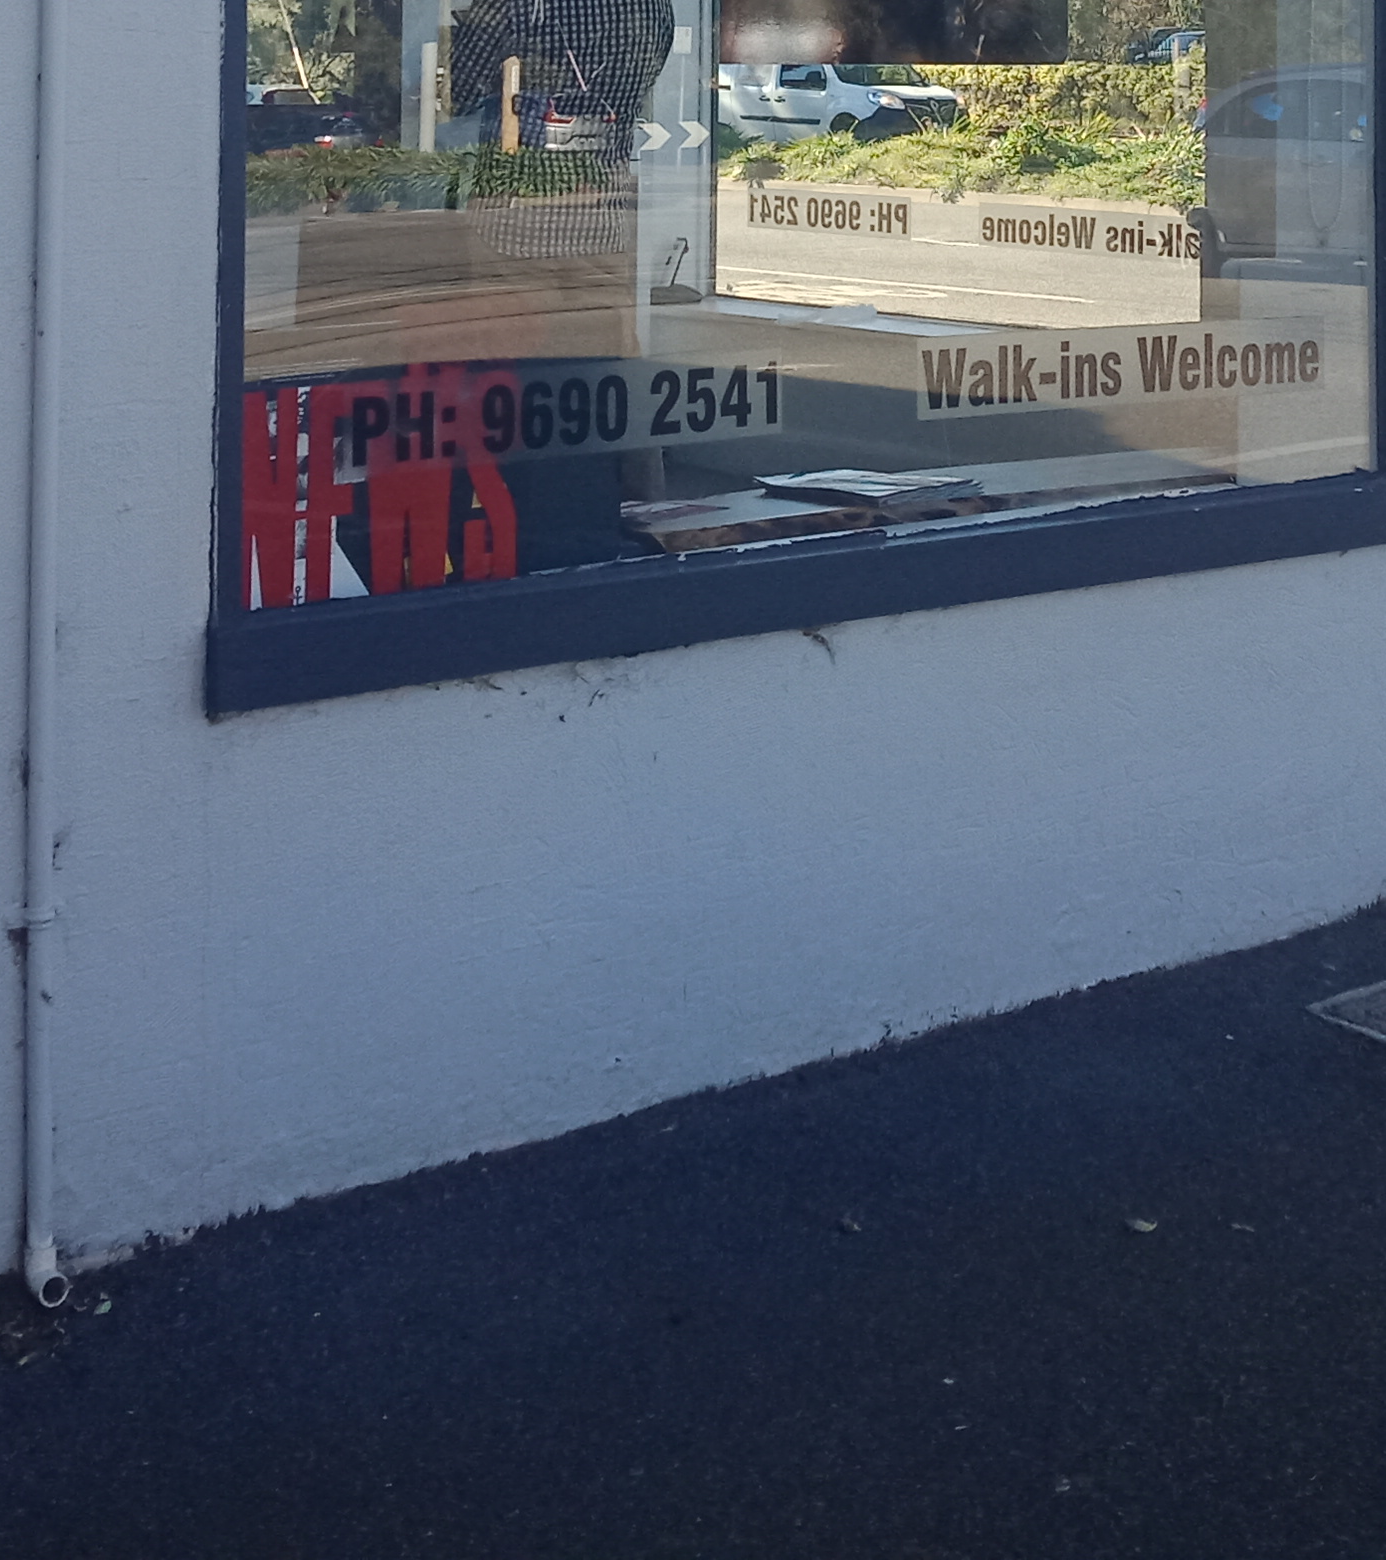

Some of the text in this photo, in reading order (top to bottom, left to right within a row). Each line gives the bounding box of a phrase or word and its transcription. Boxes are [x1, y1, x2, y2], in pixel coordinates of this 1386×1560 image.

[352, 361, 780, 467] PH: 9690 2541
[921, 334, 1319, 410] Walk-ins Welcome
